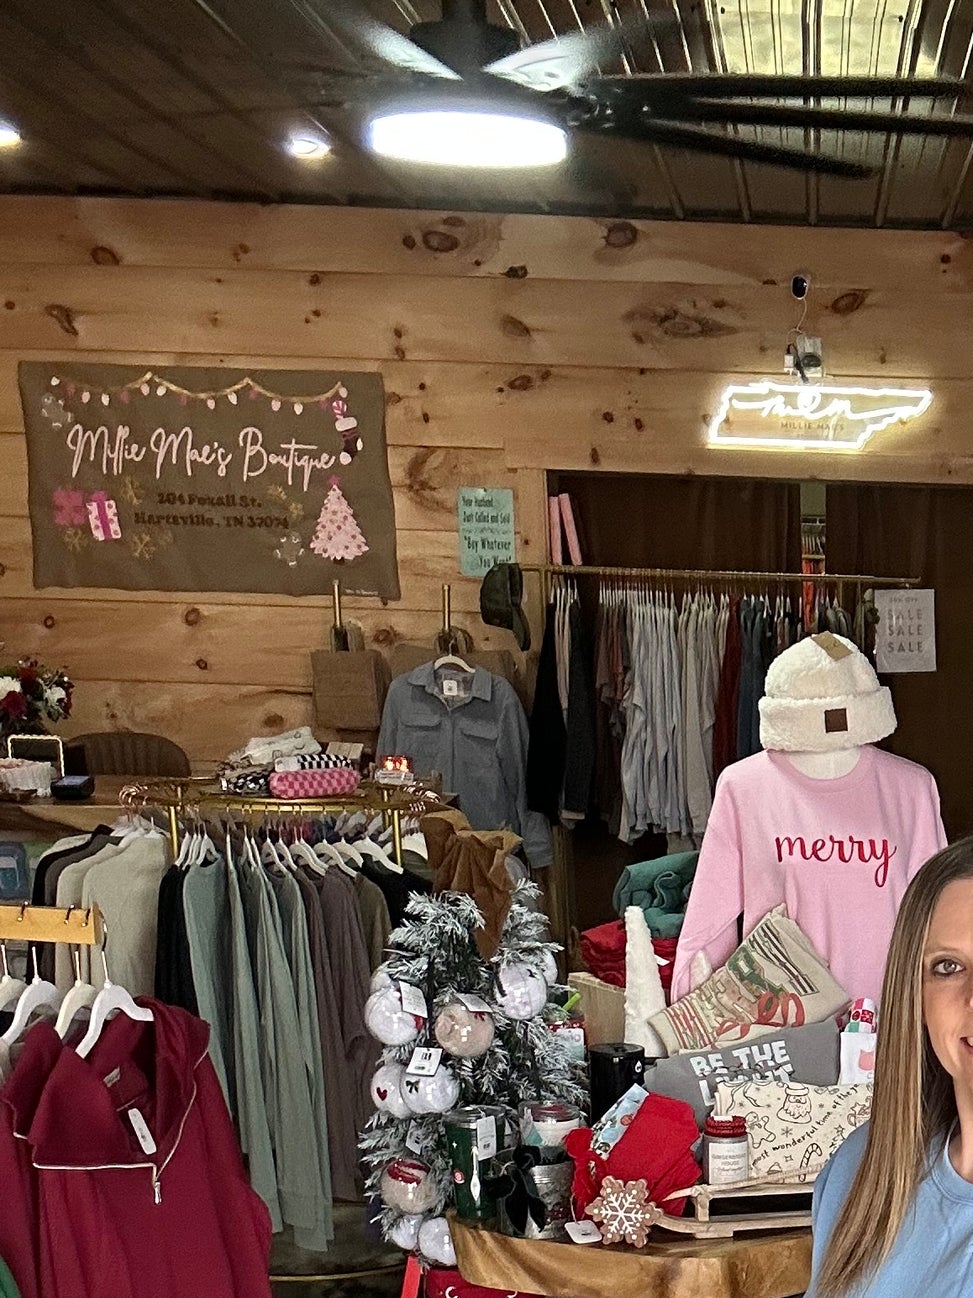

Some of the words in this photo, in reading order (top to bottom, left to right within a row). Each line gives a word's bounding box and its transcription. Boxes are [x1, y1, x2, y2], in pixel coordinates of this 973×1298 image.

[781, 421, 812, 430] MILLIE
[66, 423, 147, 478] Millie
[150, 426, 232, 479] Mae's
[238, 427, 336, 491] Boutique
[223, 515, 244, 528] TN
[480, 537, 511, 550] Whatever
[888, 608, 923, 621] SALE
[888, 624, 923, 637] SALE
[887, 641, 924, 654] SALE
[775, 834, 898, 888] merry
[689, 1052, 729, 1077] BE
[731, 1040, 791, 1070] THE
[751, 1149, 770, 1167] most
[771, 1126, 817, 1151] wonderful
[815, 1111, 833, 1126] time
